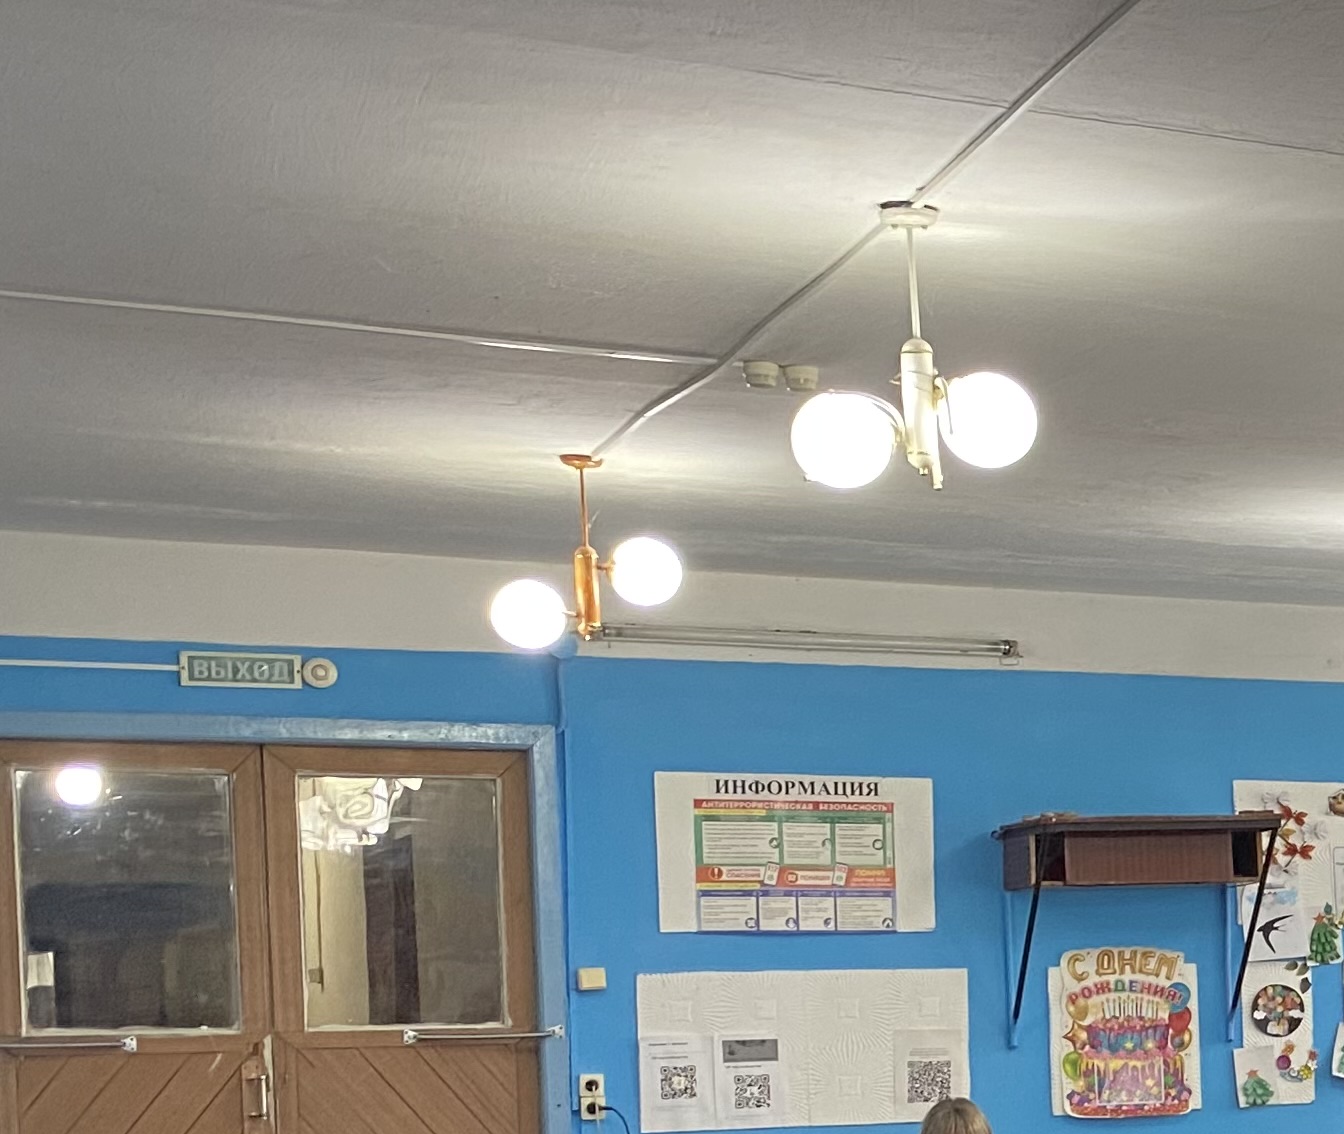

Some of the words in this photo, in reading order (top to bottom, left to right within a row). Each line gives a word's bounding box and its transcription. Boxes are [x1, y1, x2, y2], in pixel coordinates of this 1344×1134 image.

[192, 658, 291, 684] ВЫХОД
[714, 778, 880, 798] ИНФОРМАЦИЯ
[701, 800, 814, 811] АНТИТЕРРОРИСТИЧЕСКАЯ
[818, 802, 888, 812] БЕЗОПАСНОСТЬ
[1067, 952, 1090, 983] С
[1095, 949, 1179, 980] ДНЕМ
[1067, 979, 1184, 1005] РОЖДЕНИЯ!
